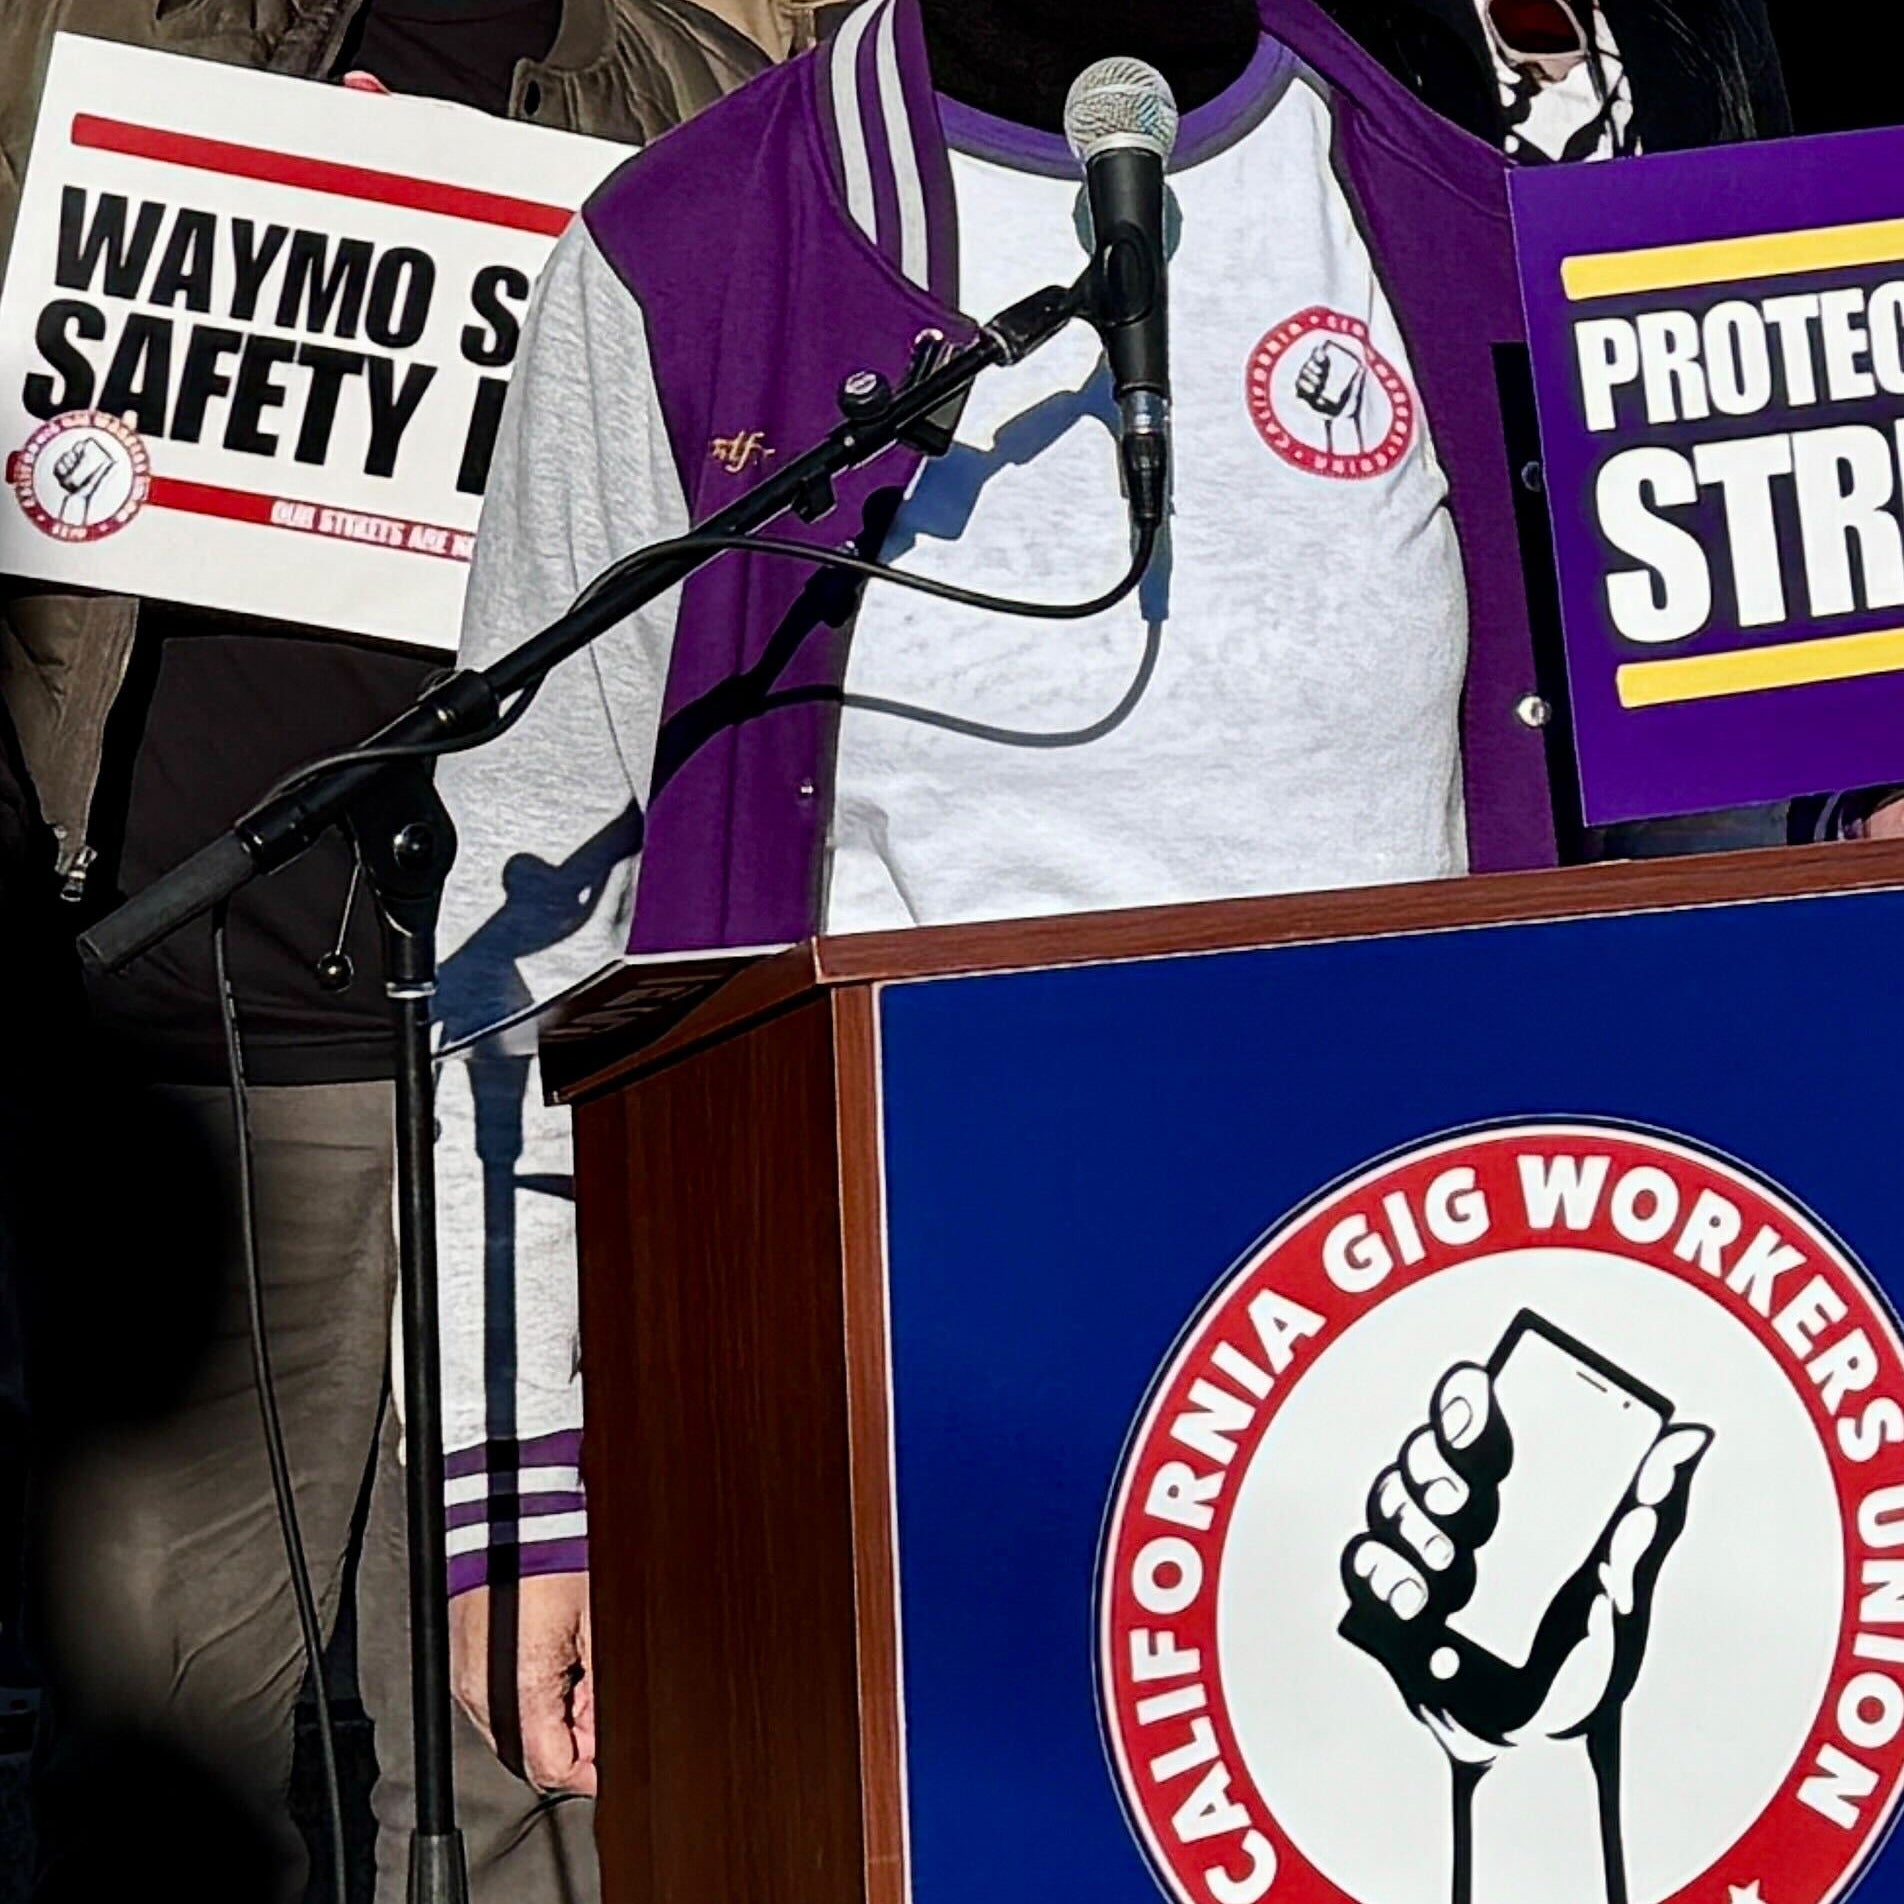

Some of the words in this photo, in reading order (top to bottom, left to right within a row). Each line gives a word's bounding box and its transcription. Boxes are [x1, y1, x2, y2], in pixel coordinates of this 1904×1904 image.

[53, 185, 436, 349] WAYMO
[22, 299, 437, 480] SAFETY
[1127, 1286, 1328, 1902] CALIFORNIA
[1321, 1166, 1492, 1294] GIG
